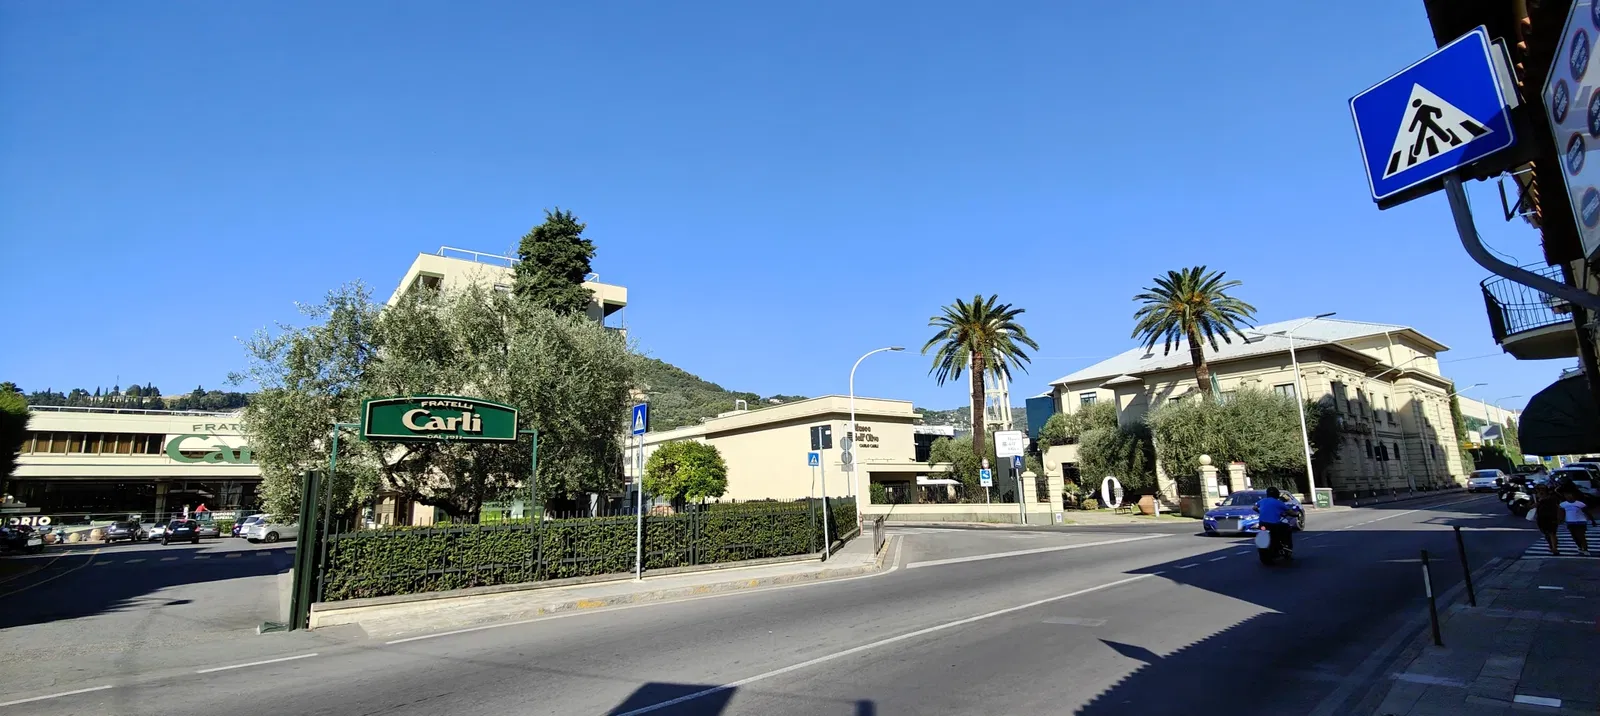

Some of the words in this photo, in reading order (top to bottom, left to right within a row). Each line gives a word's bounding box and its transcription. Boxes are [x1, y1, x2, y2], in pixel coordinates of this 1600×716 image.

[421, 400, 473, 409] FRATELLI
[192, 423, 250, 432] FRATE
[402, 409, 481, 431] Carli
[166, 434, 256, 464] Car
